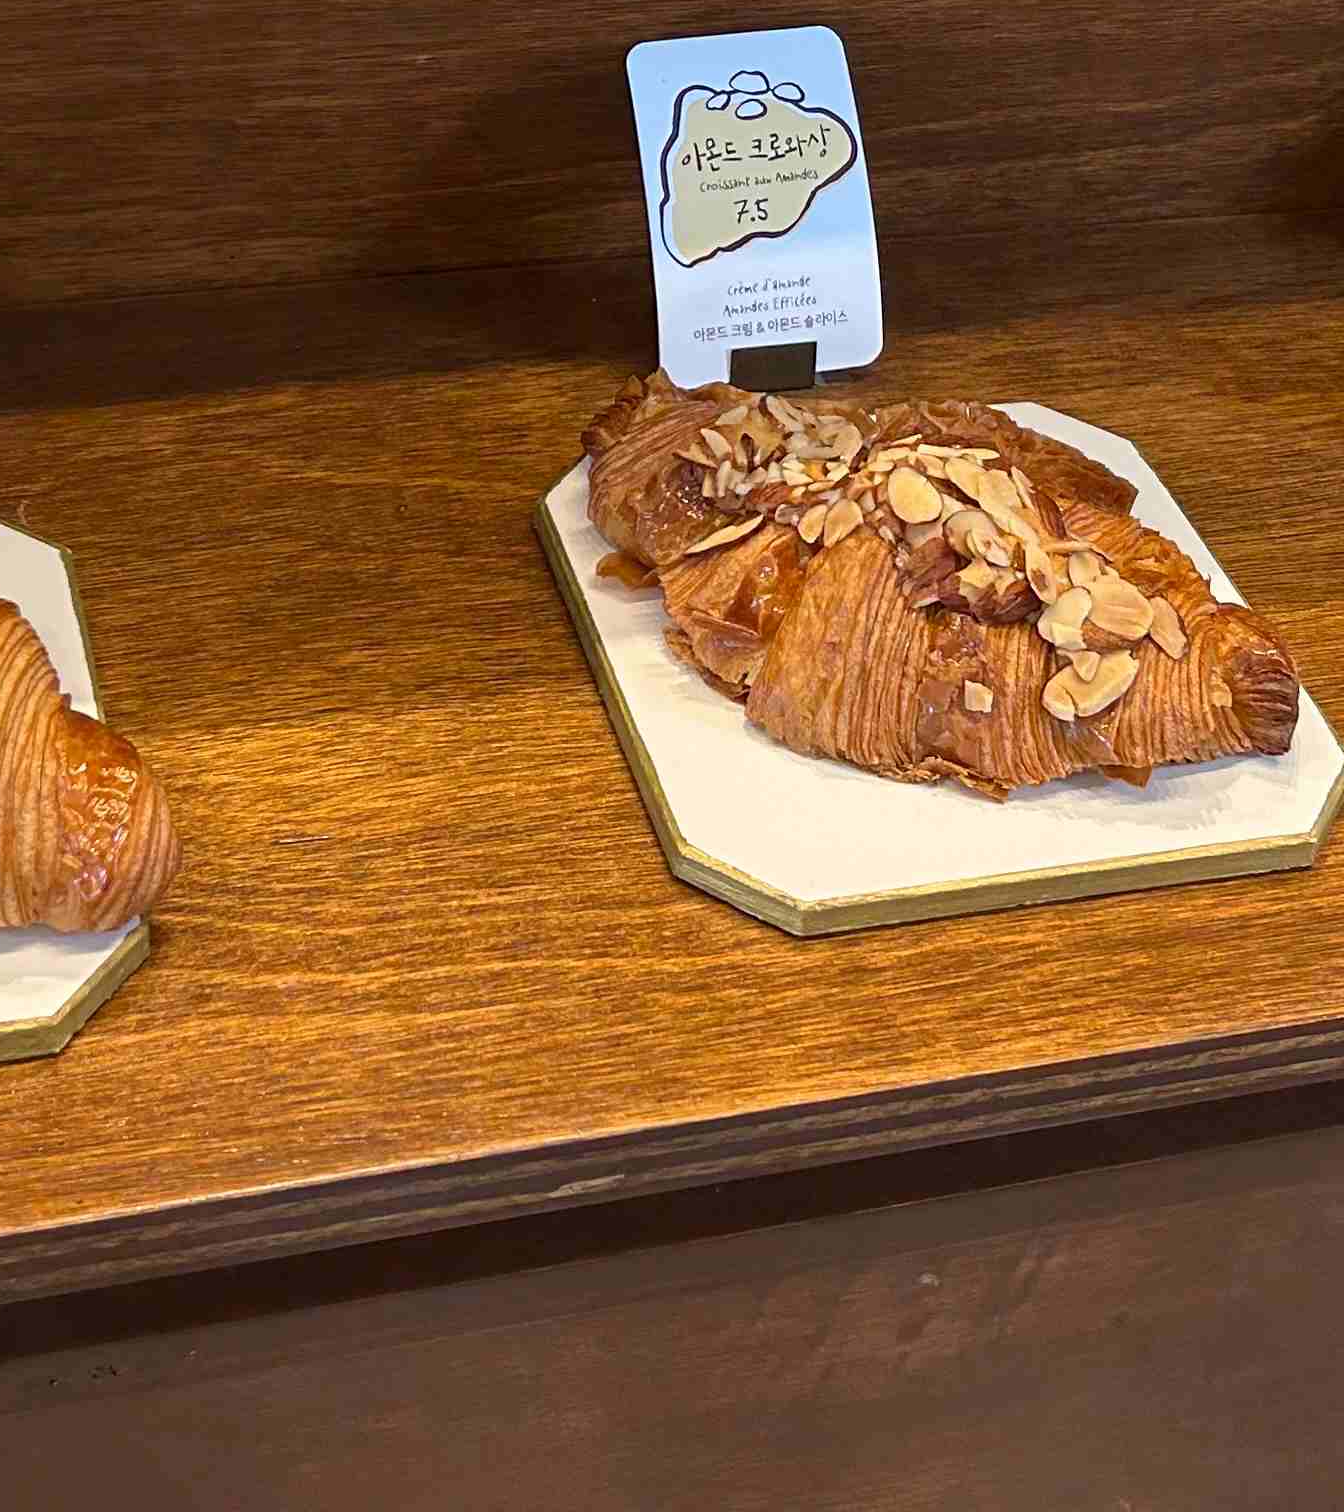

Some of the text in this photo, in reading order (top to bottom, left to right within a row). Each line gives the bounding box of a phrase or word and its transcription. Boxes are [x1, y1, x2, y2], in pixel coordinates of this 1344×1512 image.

[681, 124, 831, 172] 아몬드 크로와상
[733, 197, 770, 225] 7.5
[693, 324, 729, 343] 아몬드
[730, 320, 754, 339] 크림
[767, 315, 802, 335] 아몬드
[803, 309, 850, 330] 슬라이스
